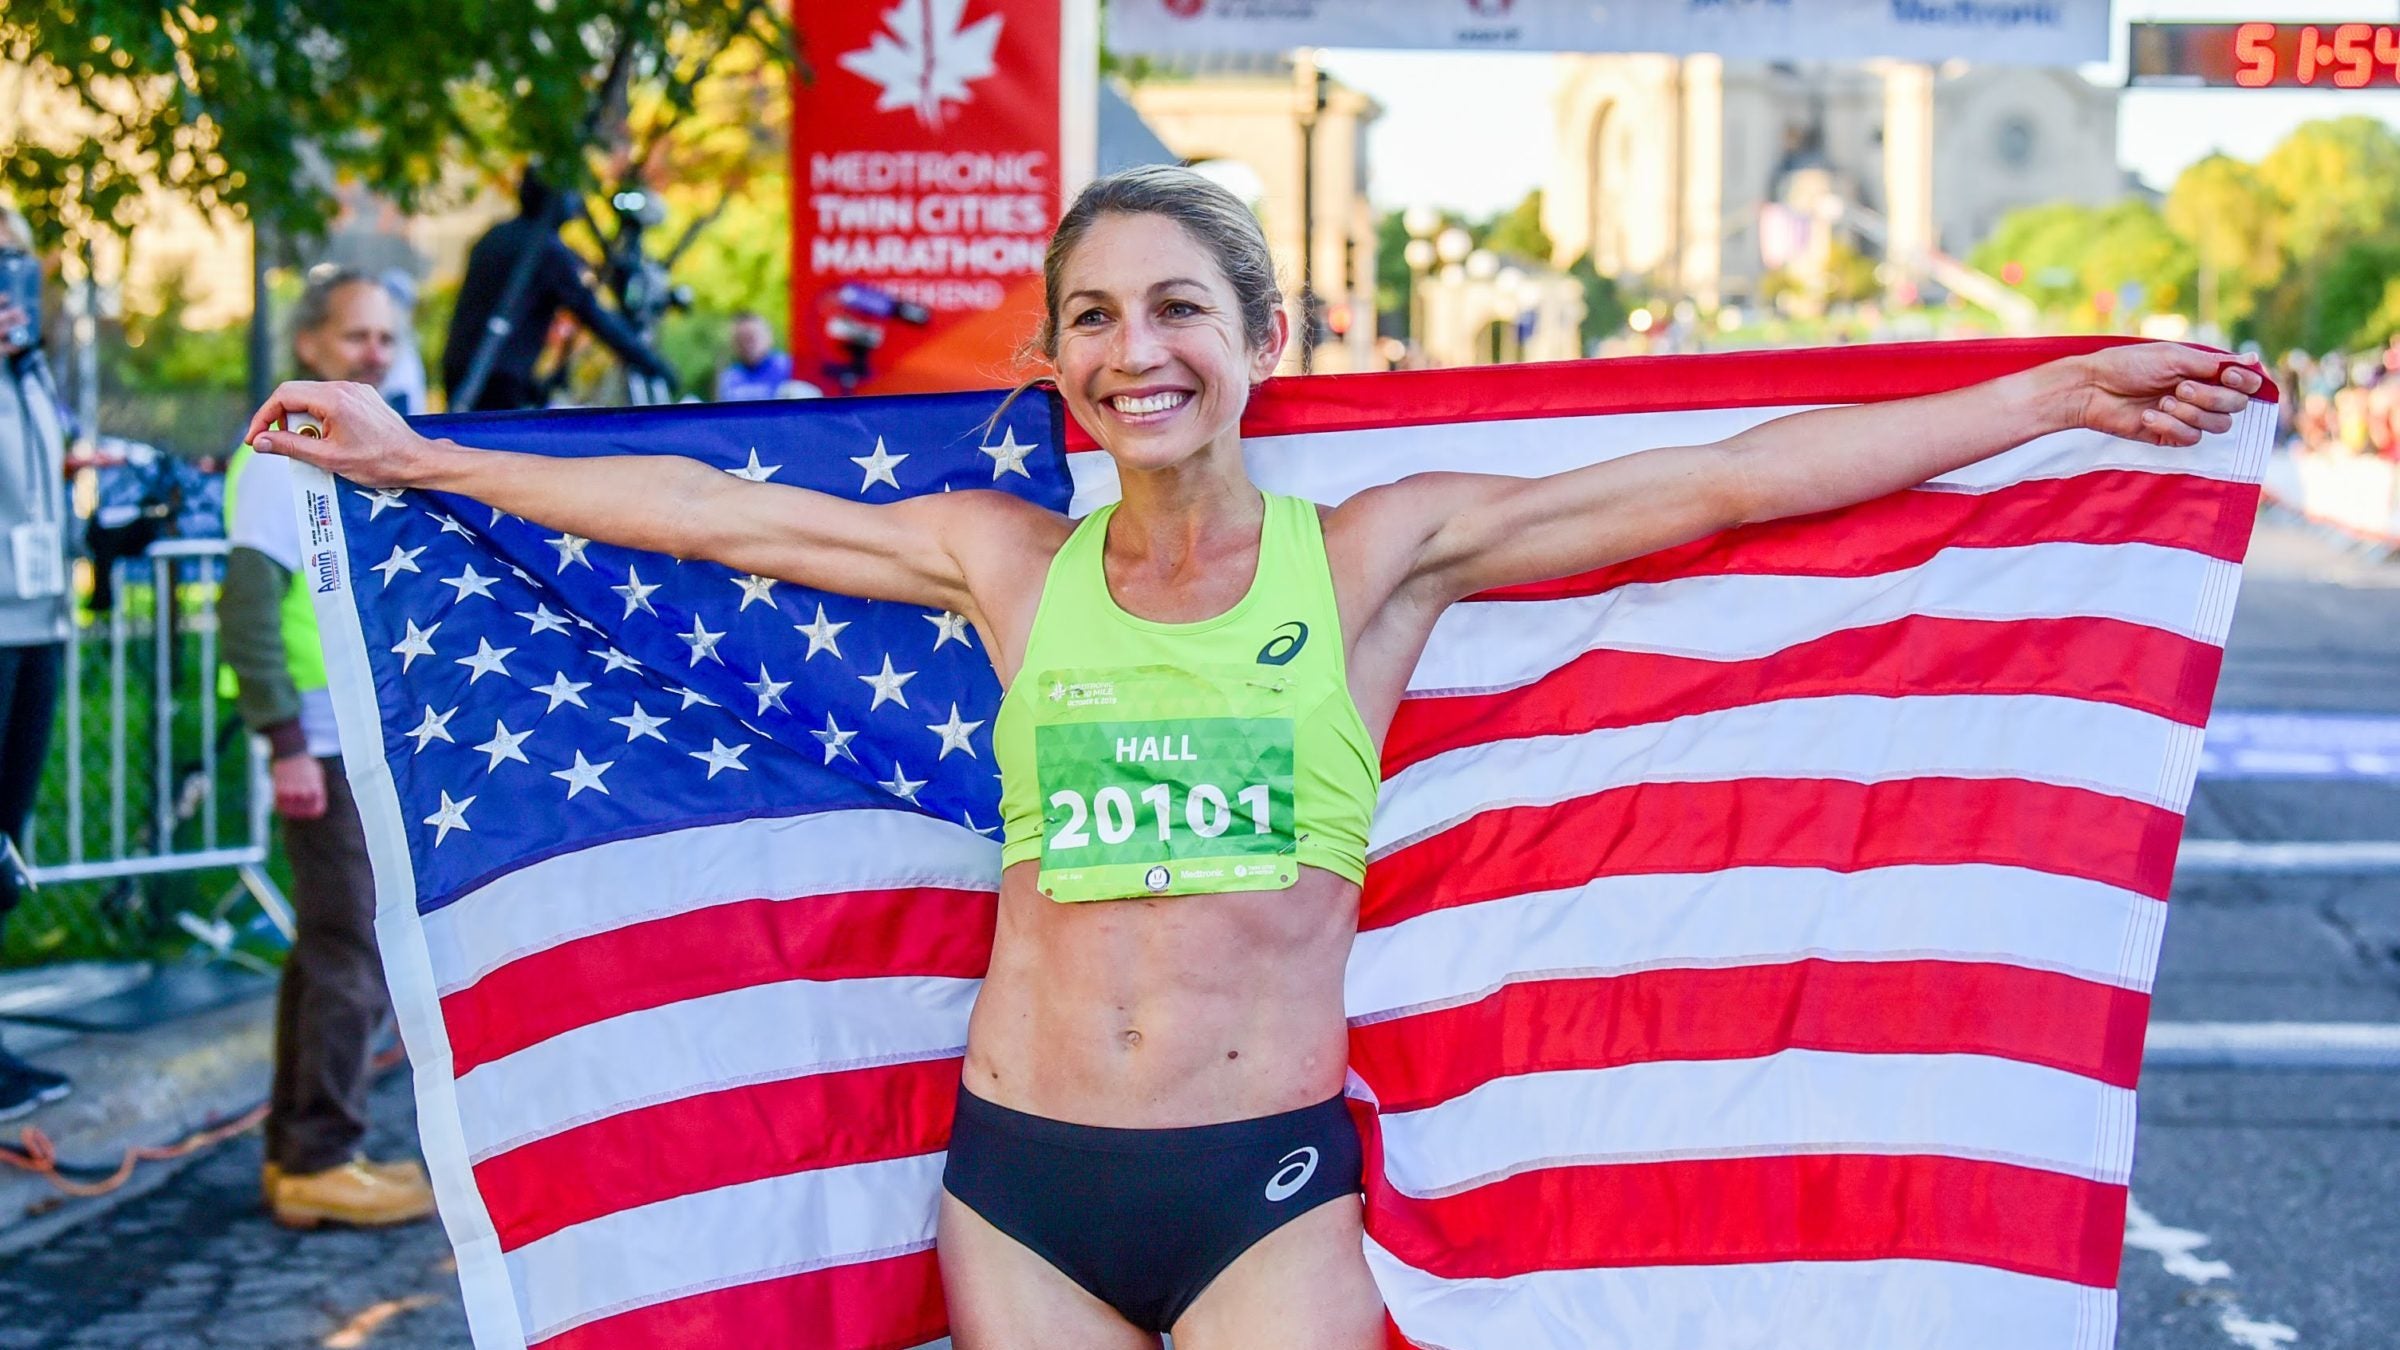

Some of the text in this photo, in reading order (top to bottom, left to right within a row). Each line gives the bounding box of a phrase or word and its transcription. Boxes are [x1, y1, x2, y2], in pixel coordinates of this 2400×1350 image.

[811, 152, 1046, 190] MEDTRONIC
[812, 194, 1046, 232] TWIN CITIES
[317, 552, 335, 593] Annin
[1115, 735, 1197, 762] HALL
[1049, 783, 1272, 849] 20101
[1180, 868, 1224, 879] Medtronic
